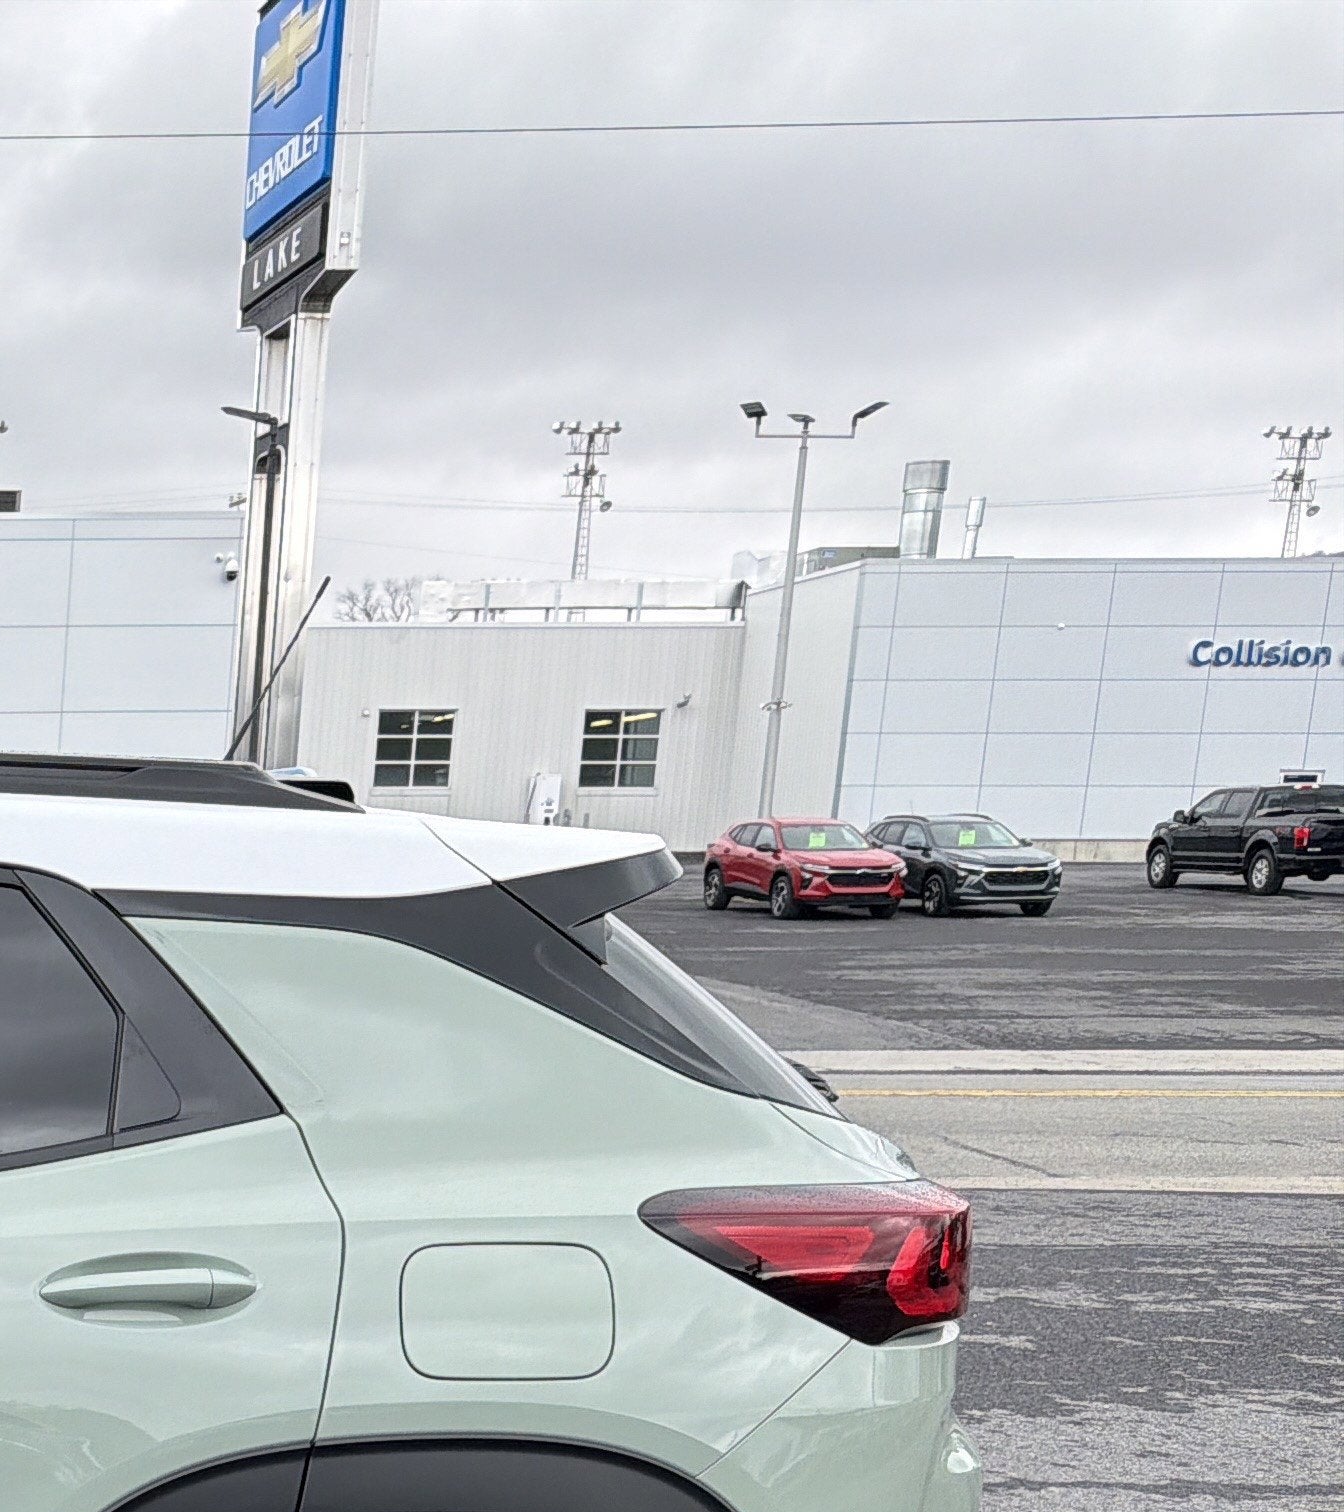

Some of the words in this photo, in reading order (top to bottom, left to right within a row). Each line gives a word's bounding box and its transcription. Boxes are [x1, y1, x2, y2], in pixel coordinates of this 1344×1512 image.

[245, 115, 323, 210] CHEVROLET
[252, 227, 302, 291] LAKE
[1189, 639, 1332, 667] Collision
